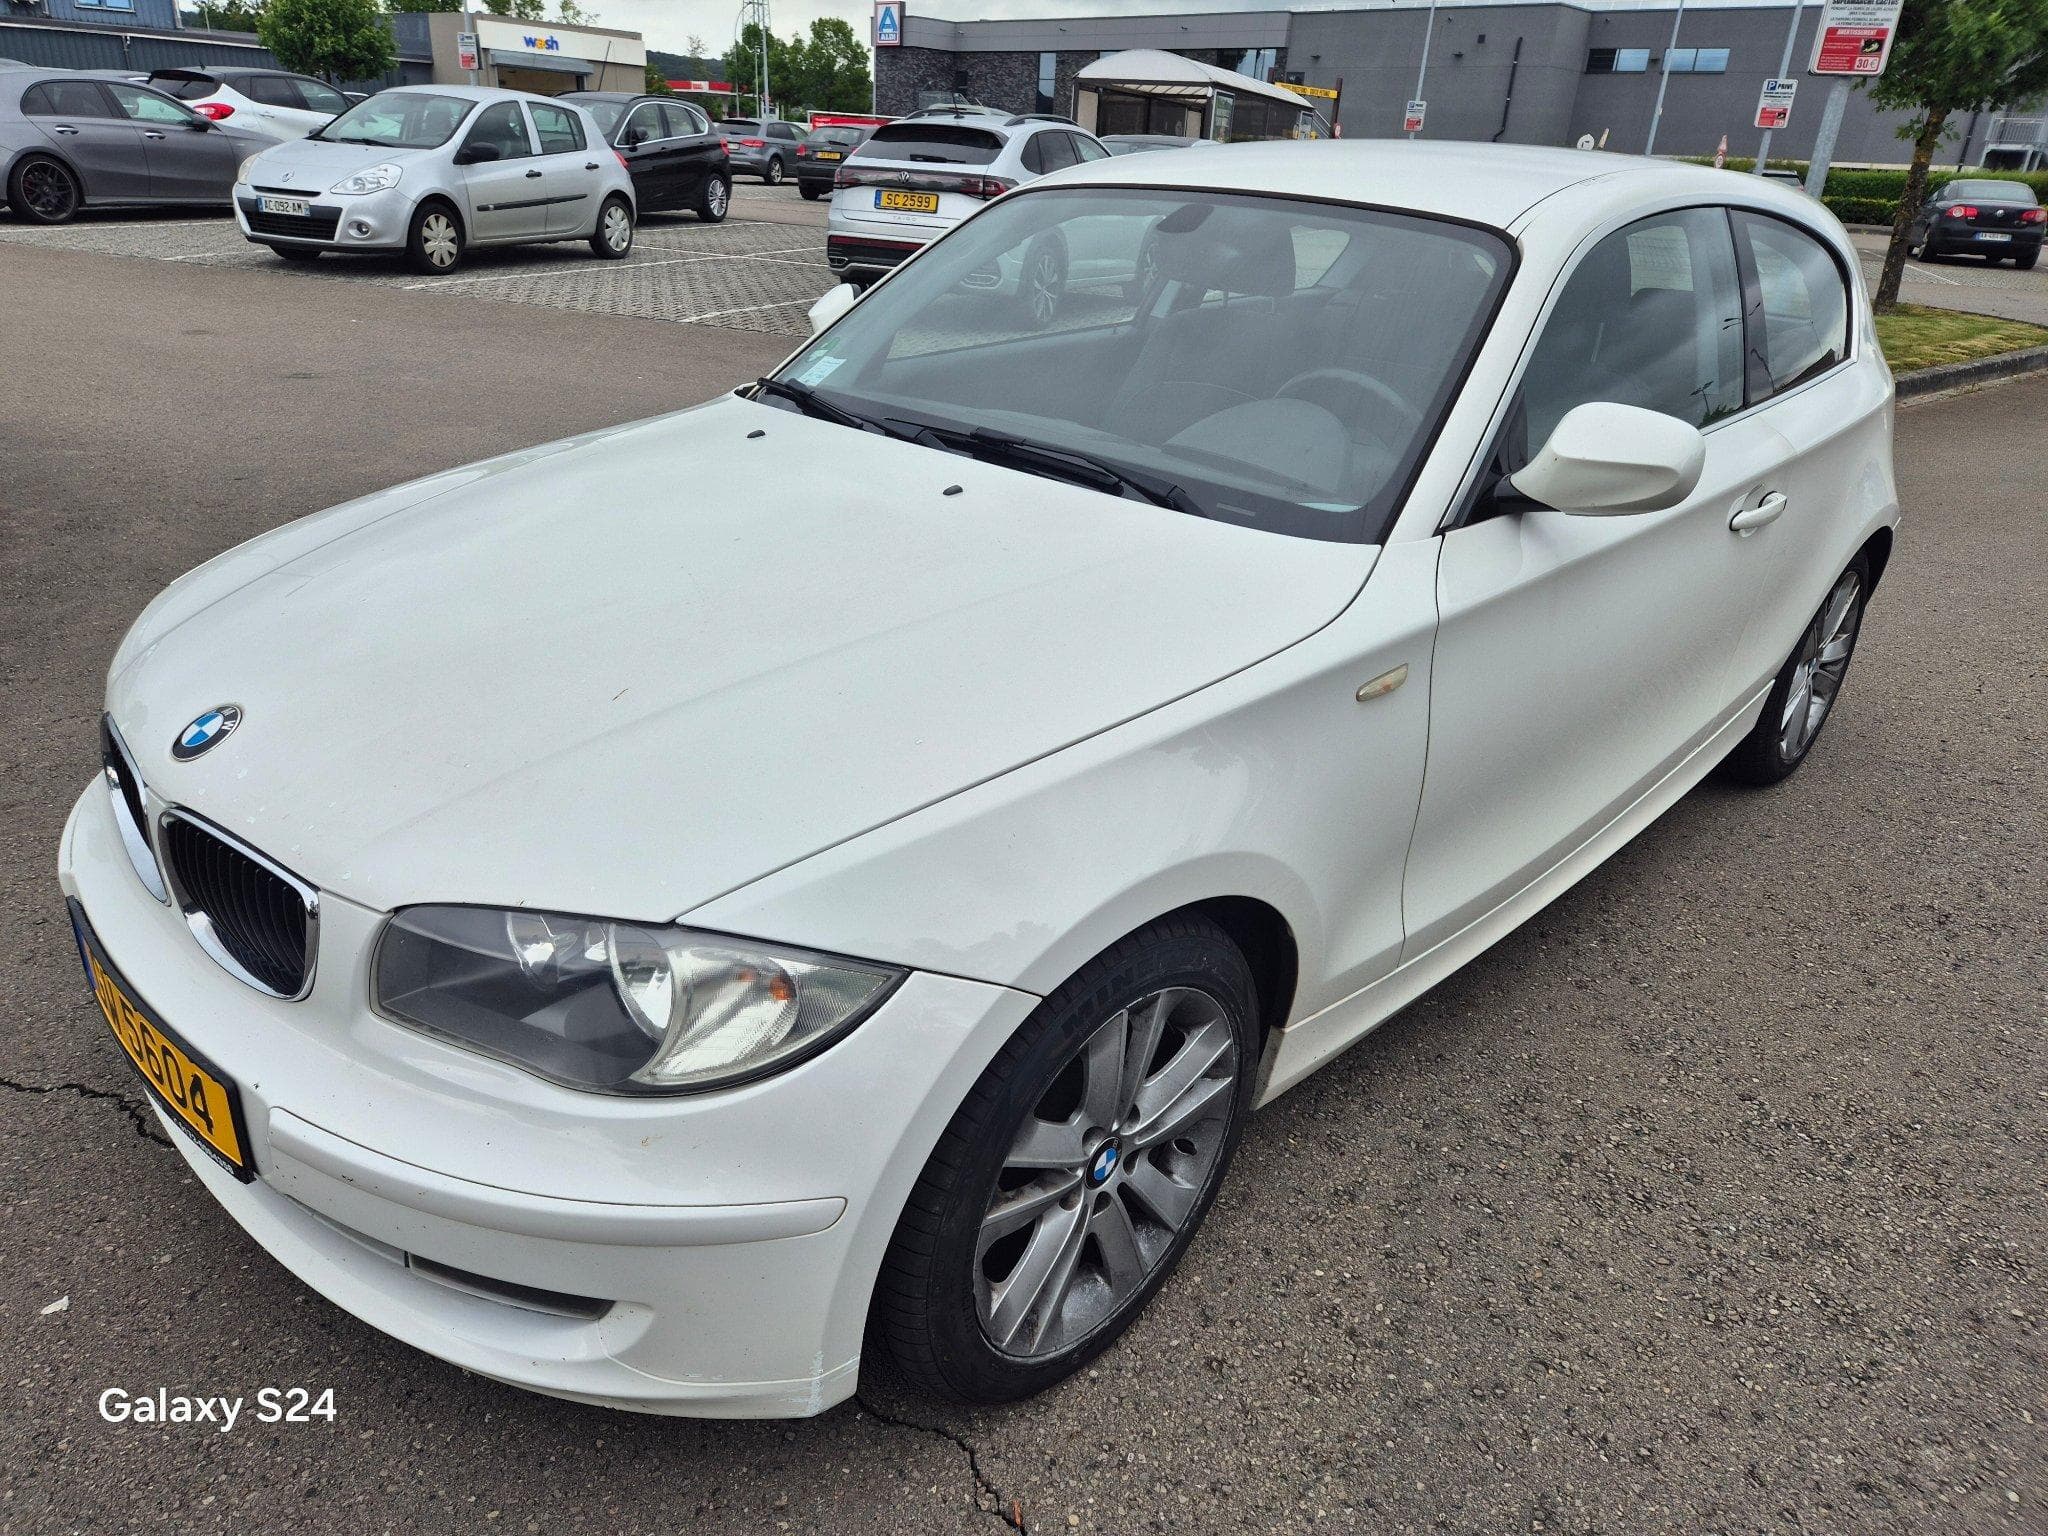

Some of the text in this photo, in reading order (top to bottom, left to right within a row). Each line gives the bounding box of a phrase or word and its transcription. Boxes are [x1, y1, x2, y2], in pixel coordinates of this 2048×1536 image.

[523, 35, 559, 51] wash
[880, 33, 896, 41] ALDI
[1856, 59, 1869, 69] 30
[887, 194, 931, 208] SC 2599
